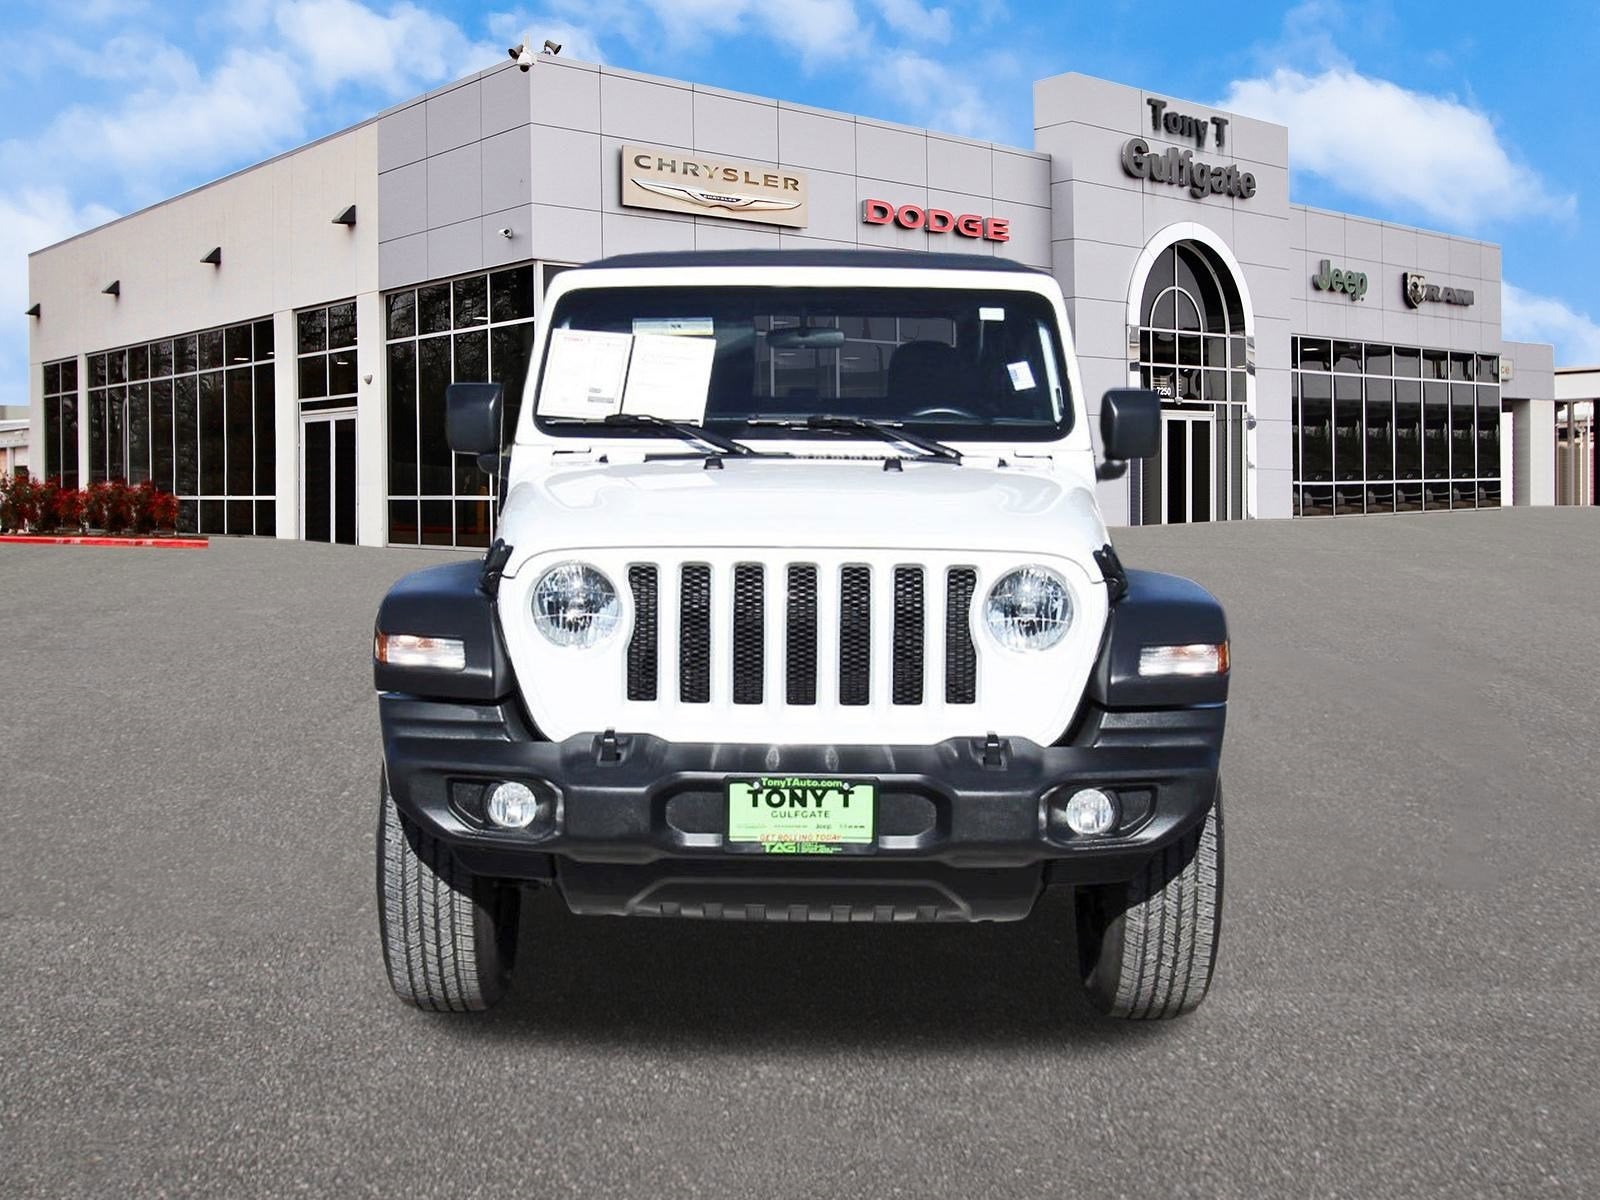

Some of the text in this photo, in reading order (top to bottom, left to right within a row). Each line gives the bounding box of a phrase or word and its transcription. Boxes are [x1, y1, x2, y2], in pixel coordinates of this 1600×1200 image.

[1146, 97, 1229, 147] Tony T
[634, 154, 800, 192] CHRYSLER
[1121, 138, 1256, 198] Gulfgate
[862, 199, 1010, 243] DODGE
[1312, 259, 1368, 302] Jeep
[1425, 284, 1474, 306] RAM
[1156, 386, 1171, 396] 7250
[761, 777, 843, 788] TonyTAuto.com
[747, 789, 855, 808] TONY T
[770, 810, 831, 819] GULFGATE
